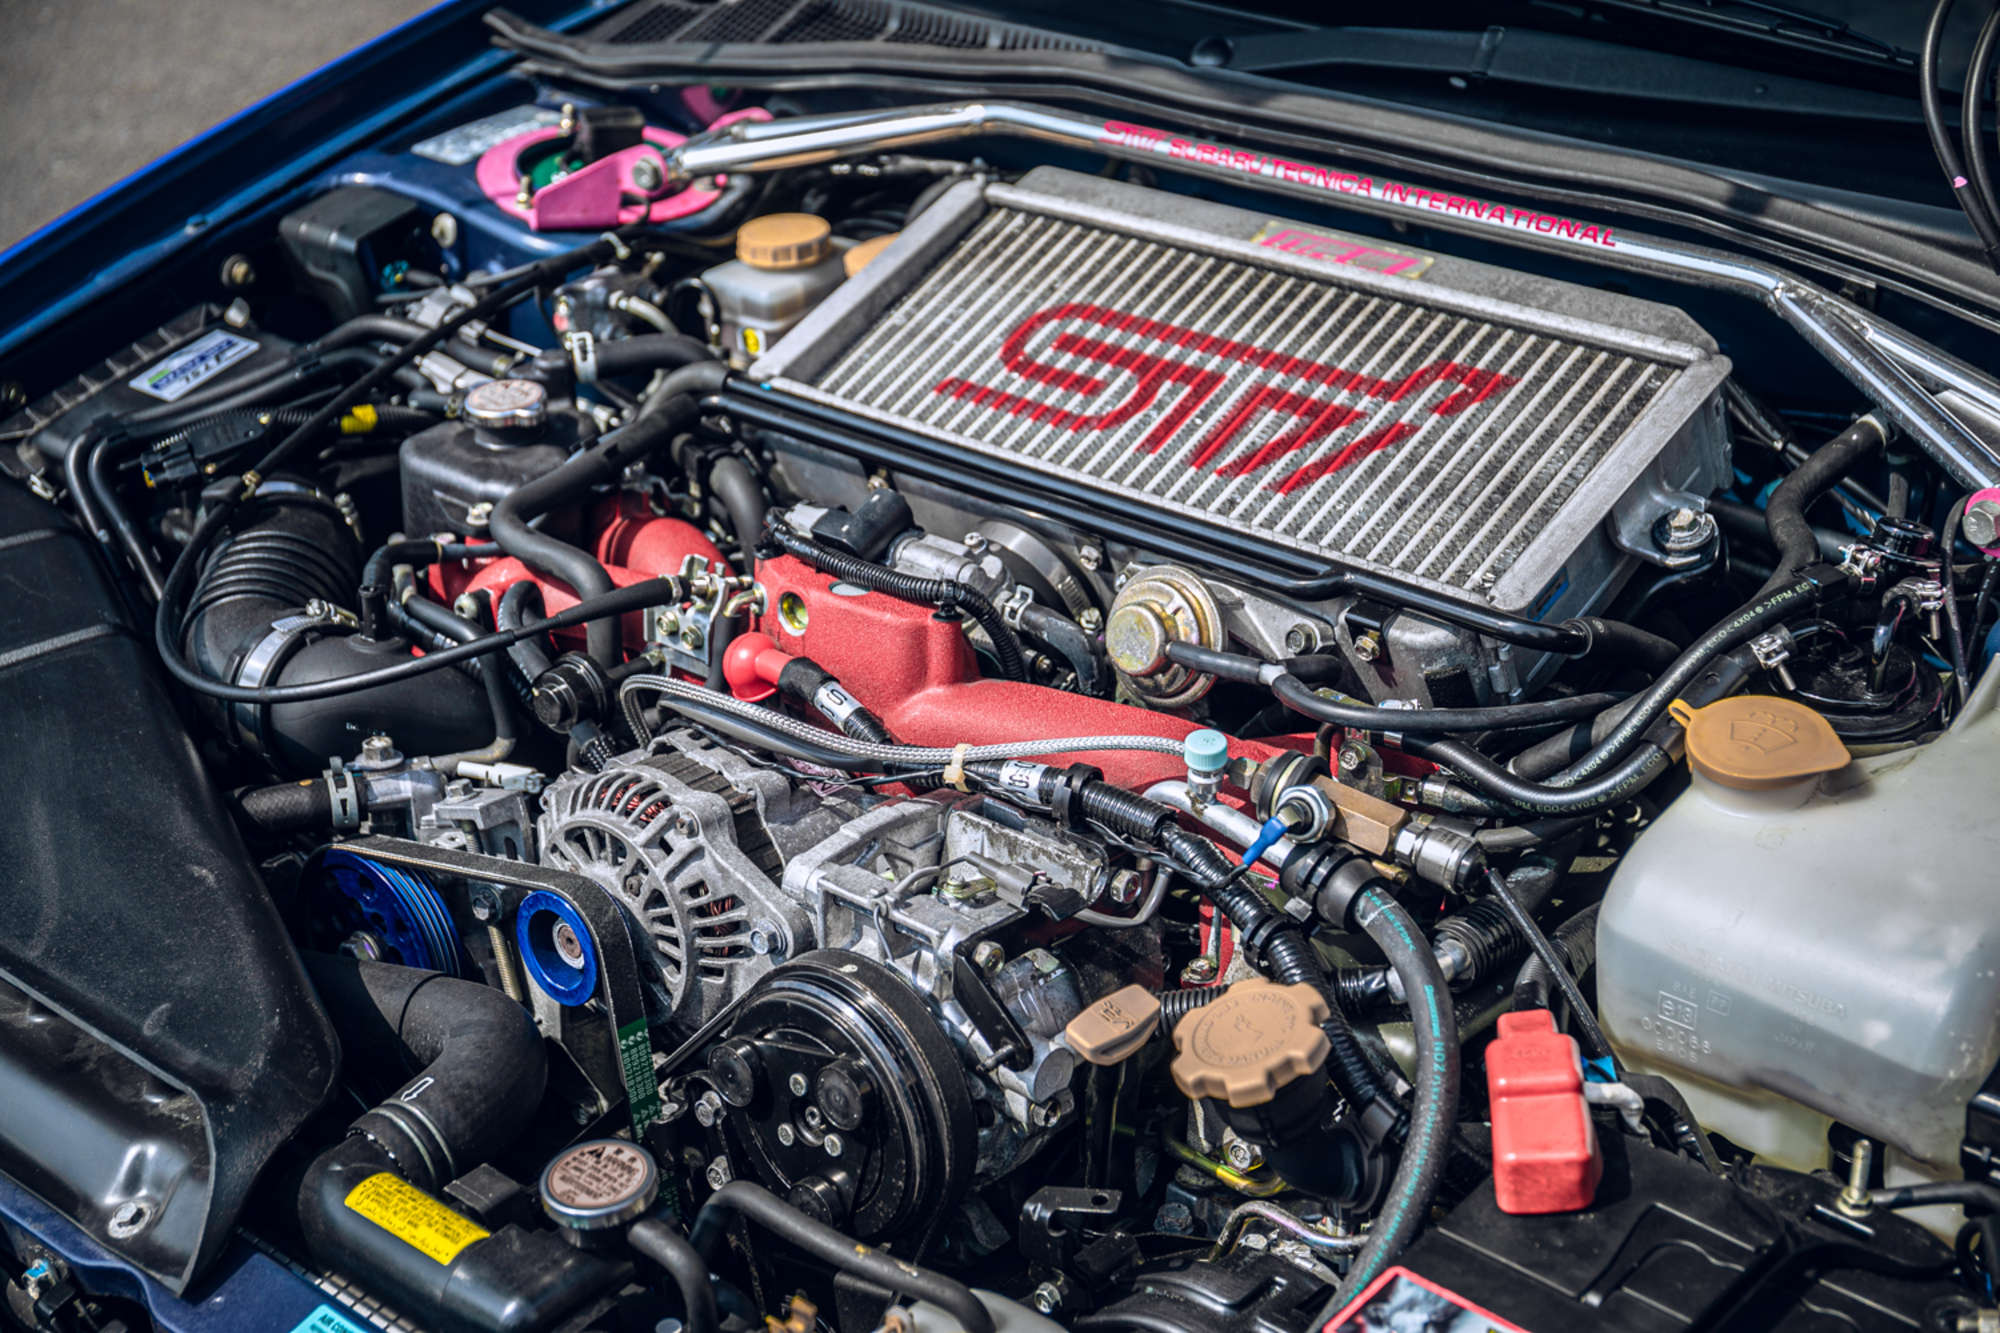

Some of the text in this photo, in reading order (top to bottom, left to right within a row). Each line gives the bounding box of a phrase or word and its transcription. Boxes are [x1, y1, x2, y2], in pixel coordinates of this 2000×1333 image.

[1168, 138, 1269, 175] SUBARU
[1271, 158, 1371, 198] TECNICA
[1382, 182, 1617, 248] INTERNATIONAL
